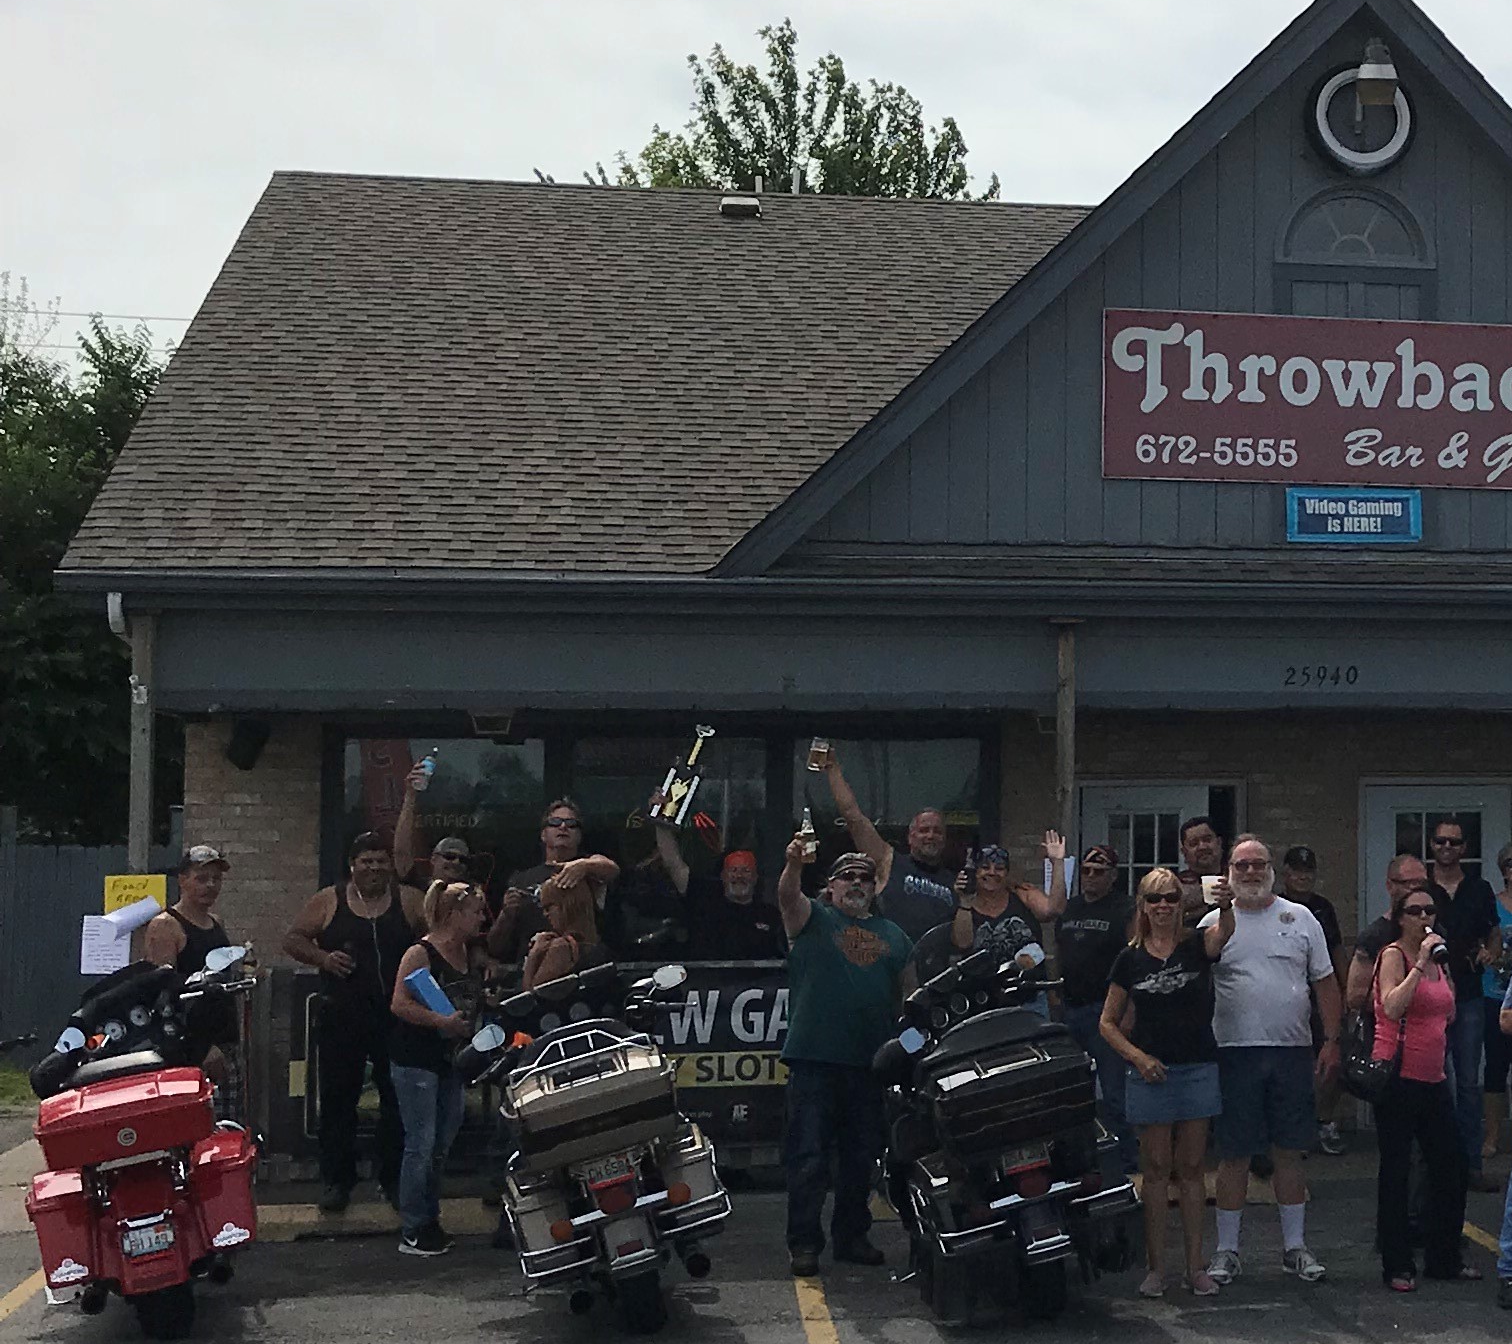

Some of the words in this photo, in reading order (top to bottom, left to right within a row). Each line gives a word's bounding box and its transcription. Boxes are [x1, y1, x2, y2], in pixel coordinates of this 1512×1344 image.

[1135, 433, 1298, 468] 672-5555
[1343, 428, 1425, 468] Bar
[1437, 431, 1470, 468] &
[1305, 498, 1346, 515] Video
[1348, 499, 1403, 517] Gaming
[1327, 517, 1341, 533] is
[1343, 517, 1382, 533] HERE!
[1284, 664, 1359, 687] 25940
[414, 813, 479, 829] ERTIFIED
[695, 1054, 788, 1083] SLOT
